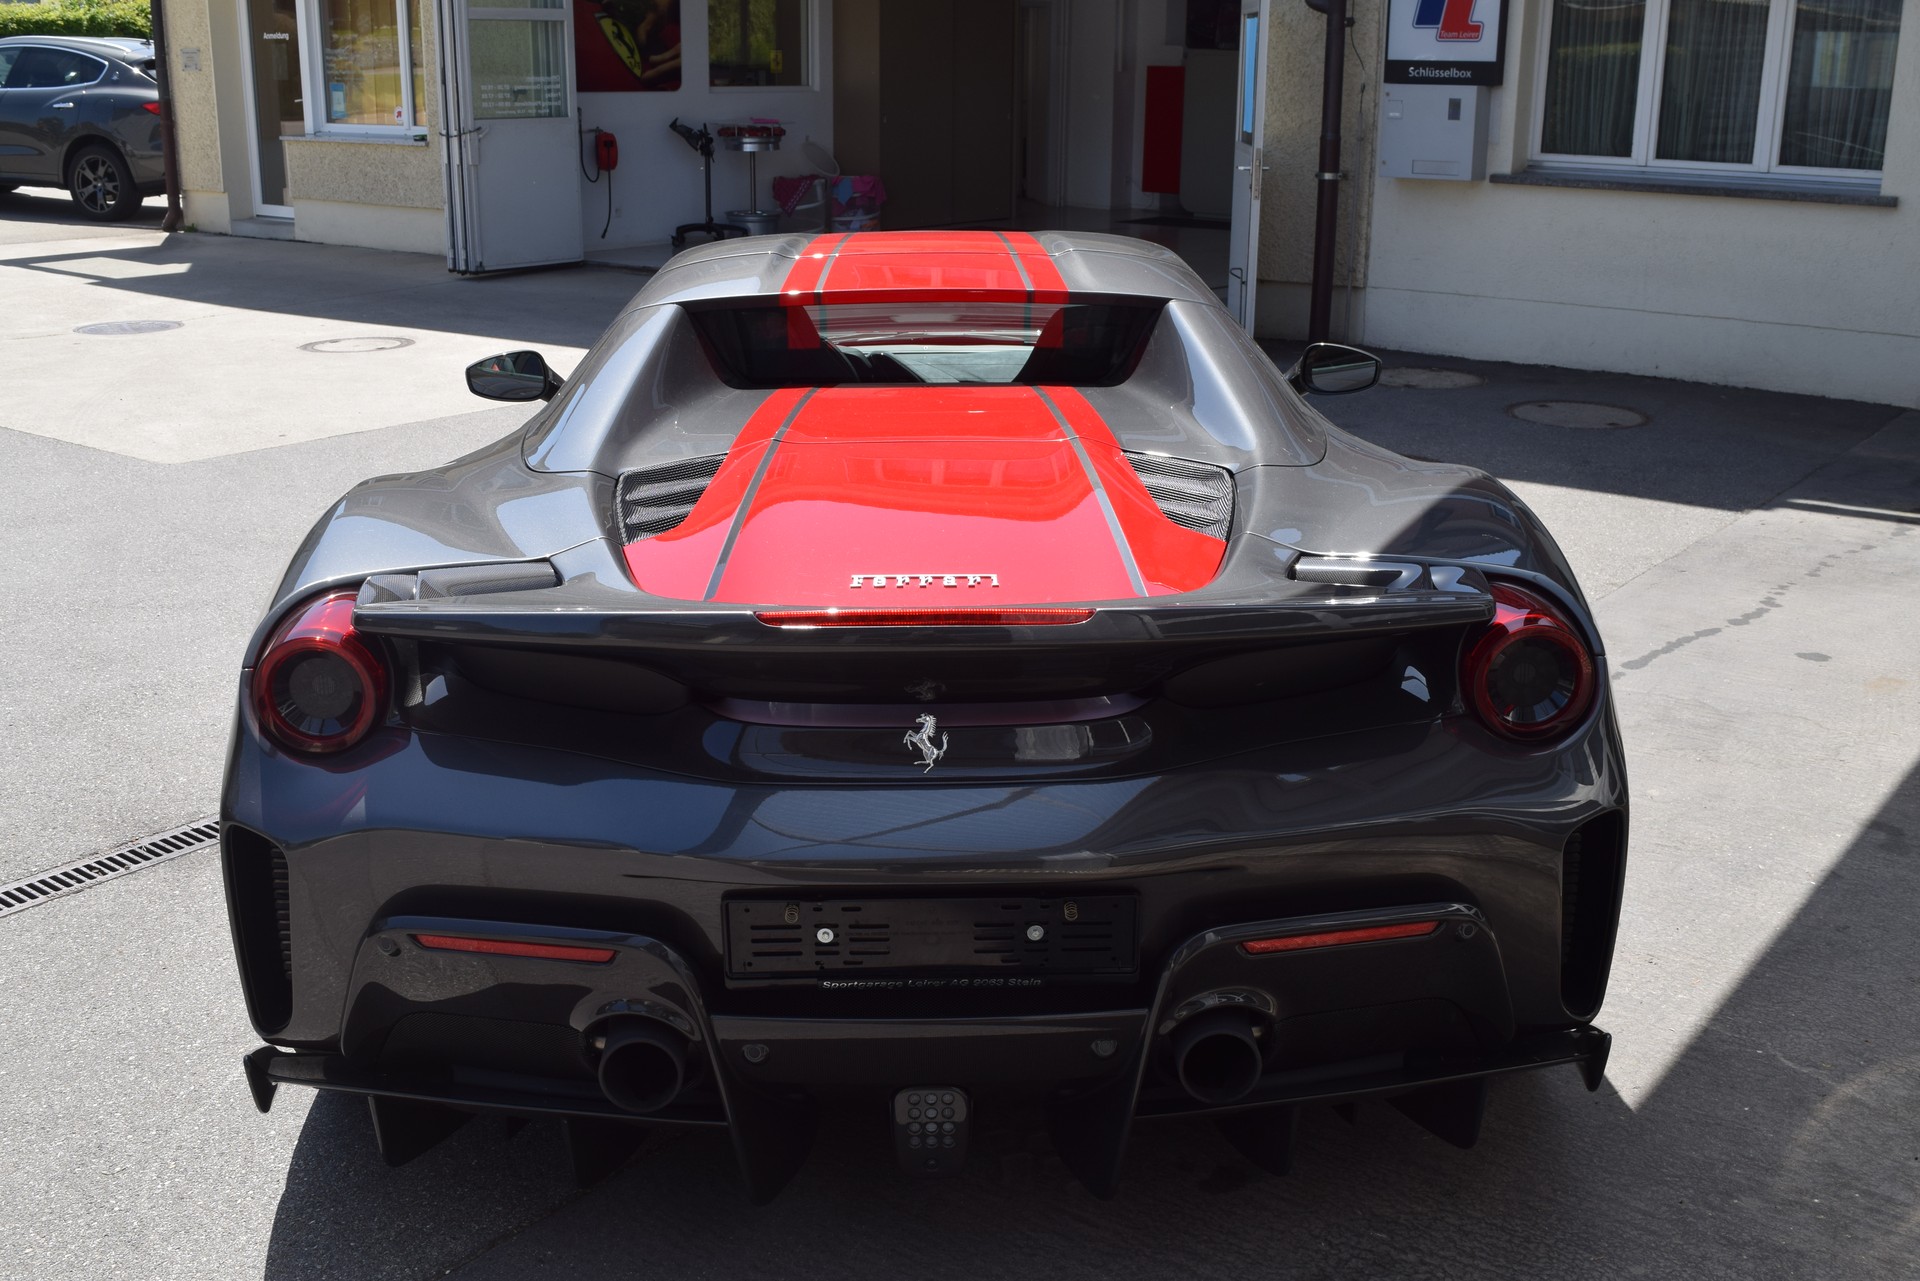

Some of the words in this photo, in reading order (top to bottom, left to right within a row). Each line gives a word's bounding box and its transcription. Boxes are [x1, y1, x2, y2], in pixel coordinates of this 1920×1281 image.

[263, 31, 290, 41] Anmeldung
[1408, 66, 1472, 79] Schlüsselbox
[850, 573, 1000, 588] Ferrari
[822, 980, 903, 990] Sportgarage
[972, 978, 1004, 986] 9063
[1007, 978, 1042, 986] Stein
